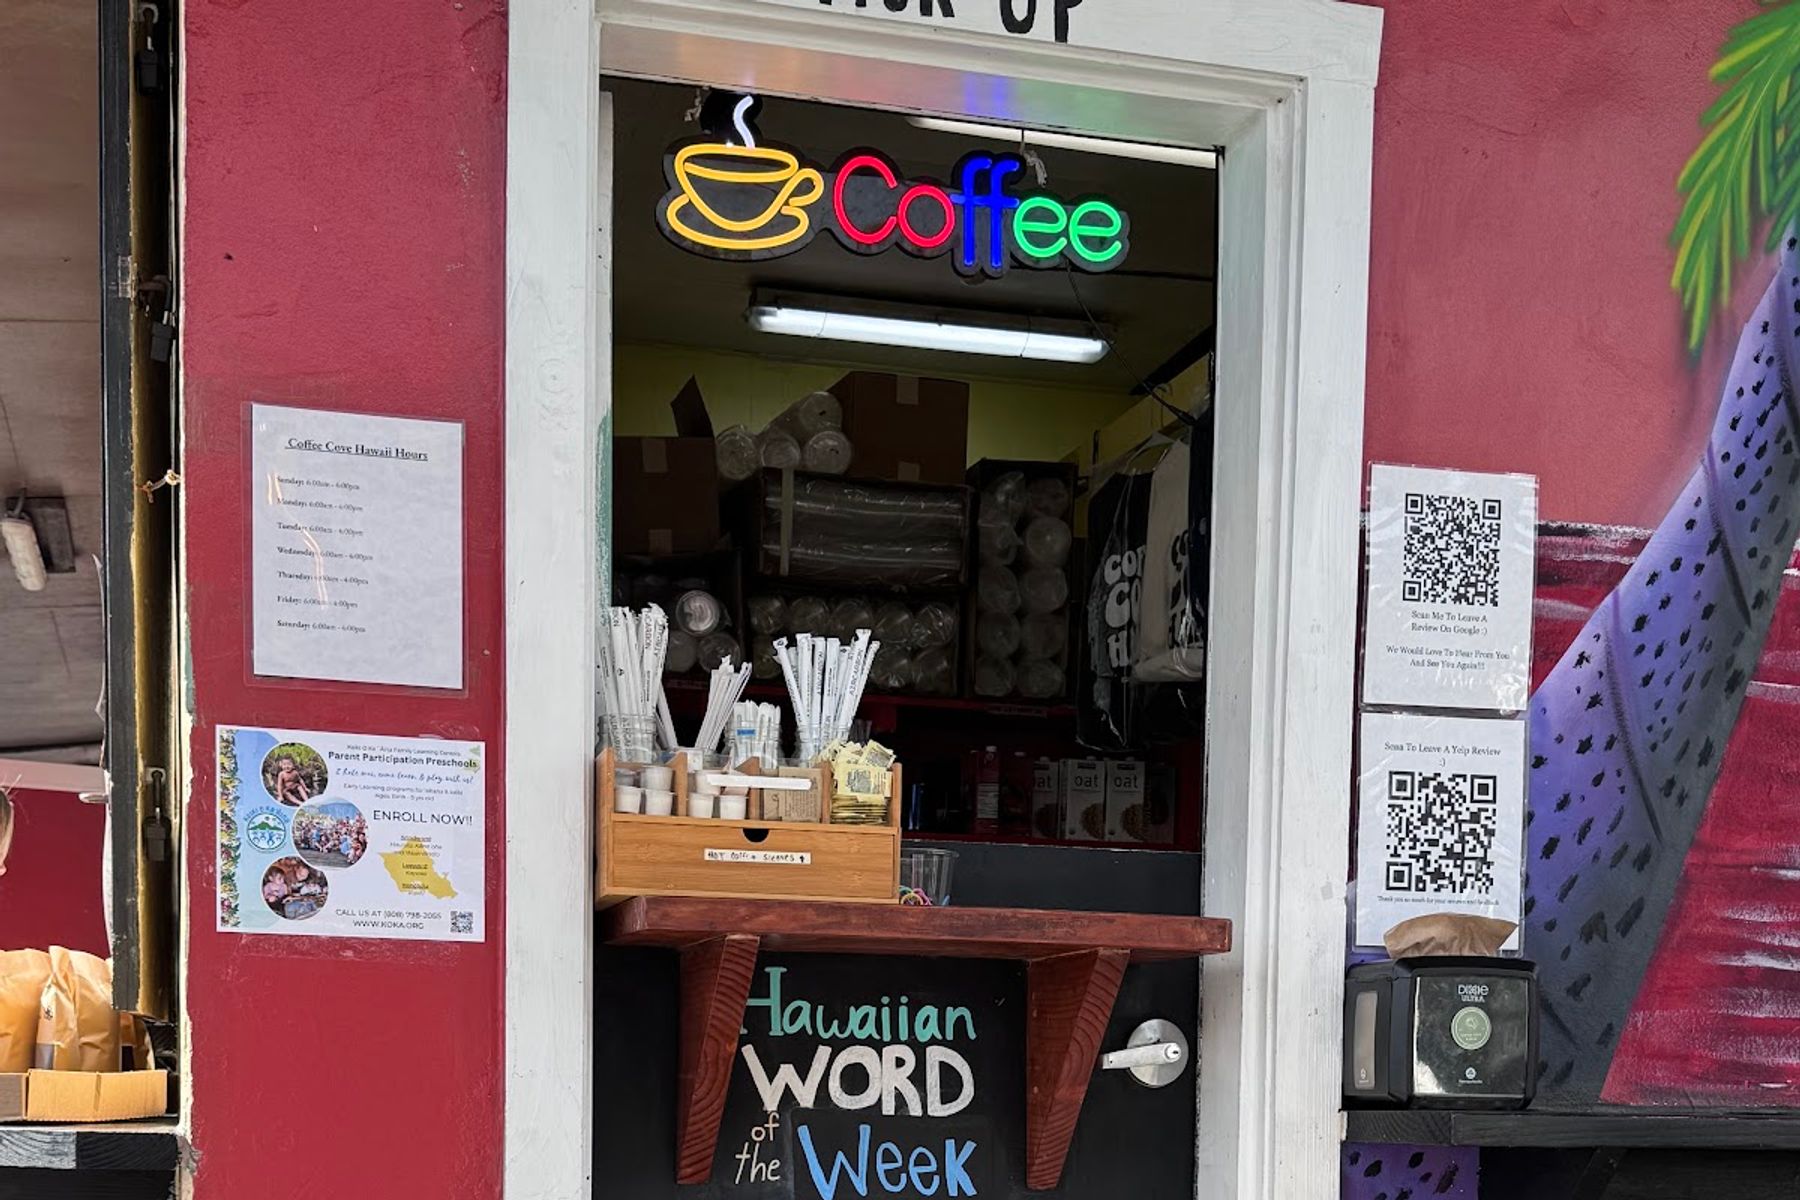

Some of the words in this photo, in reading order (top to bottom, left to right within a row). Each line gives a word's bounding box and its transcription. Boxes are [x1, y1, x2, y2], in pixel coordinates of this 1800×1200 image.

[833, 156, 1122, 267] Coffee
[288, 438, 322, 451] Coffee
[326, 441, 352, 453] Cove
[356, 444, 392, 457] Hawaii
[396, 448, 428, 460] Hours
[277, 546, 317, 558] Wednesday
[1412, 610, 1430, 619] Scan
[1432, 612, 1443, 620] Me
[1446, 612, 1456, 620] To
[1458, 613, 1480, 622] Leave
[1411, 623, 1438, 632] Review
[1440, 624, 1451, 633] On
[1453, 625, 1480, 636] Google
[1386, 645, 1398, 653] We
[1400, 646, 1423, 655] Would
[1425, 648, 1442, 656] Love
[1444, 648, 1454, 656] To
[1475, 650, 1494, 659] From
[1496, 651, 1510, 660] You
[1410, 659, 1424, 667] And
[1426, 659, 1439, 667] See
[1406, 743, 1417, 752] To
[1419, 743, 1441, 753] Leave
[1443, 745, 1450, 753] A
[1452, 745, 1470, 756] Yelp
[1471, 746, 1501, 756] Review
[329, 751, 360, 760] Parent
[362, 753, 424, 765] Participation
[426, 757, 477, 768] Preschools
[1074, 775, 1099, 788] oat
[1114, 775, 1139, 789] oat
[373, 810, 427, 823] ENROLL
[431, 814, 473, 826] NOW!!
[740, 966, 977, 1042] Hawaiian
[741, 1044, 975, 1117] WORD
[751, 1111, 780, 1141] of
[735, 1142, 781, 1184] the
